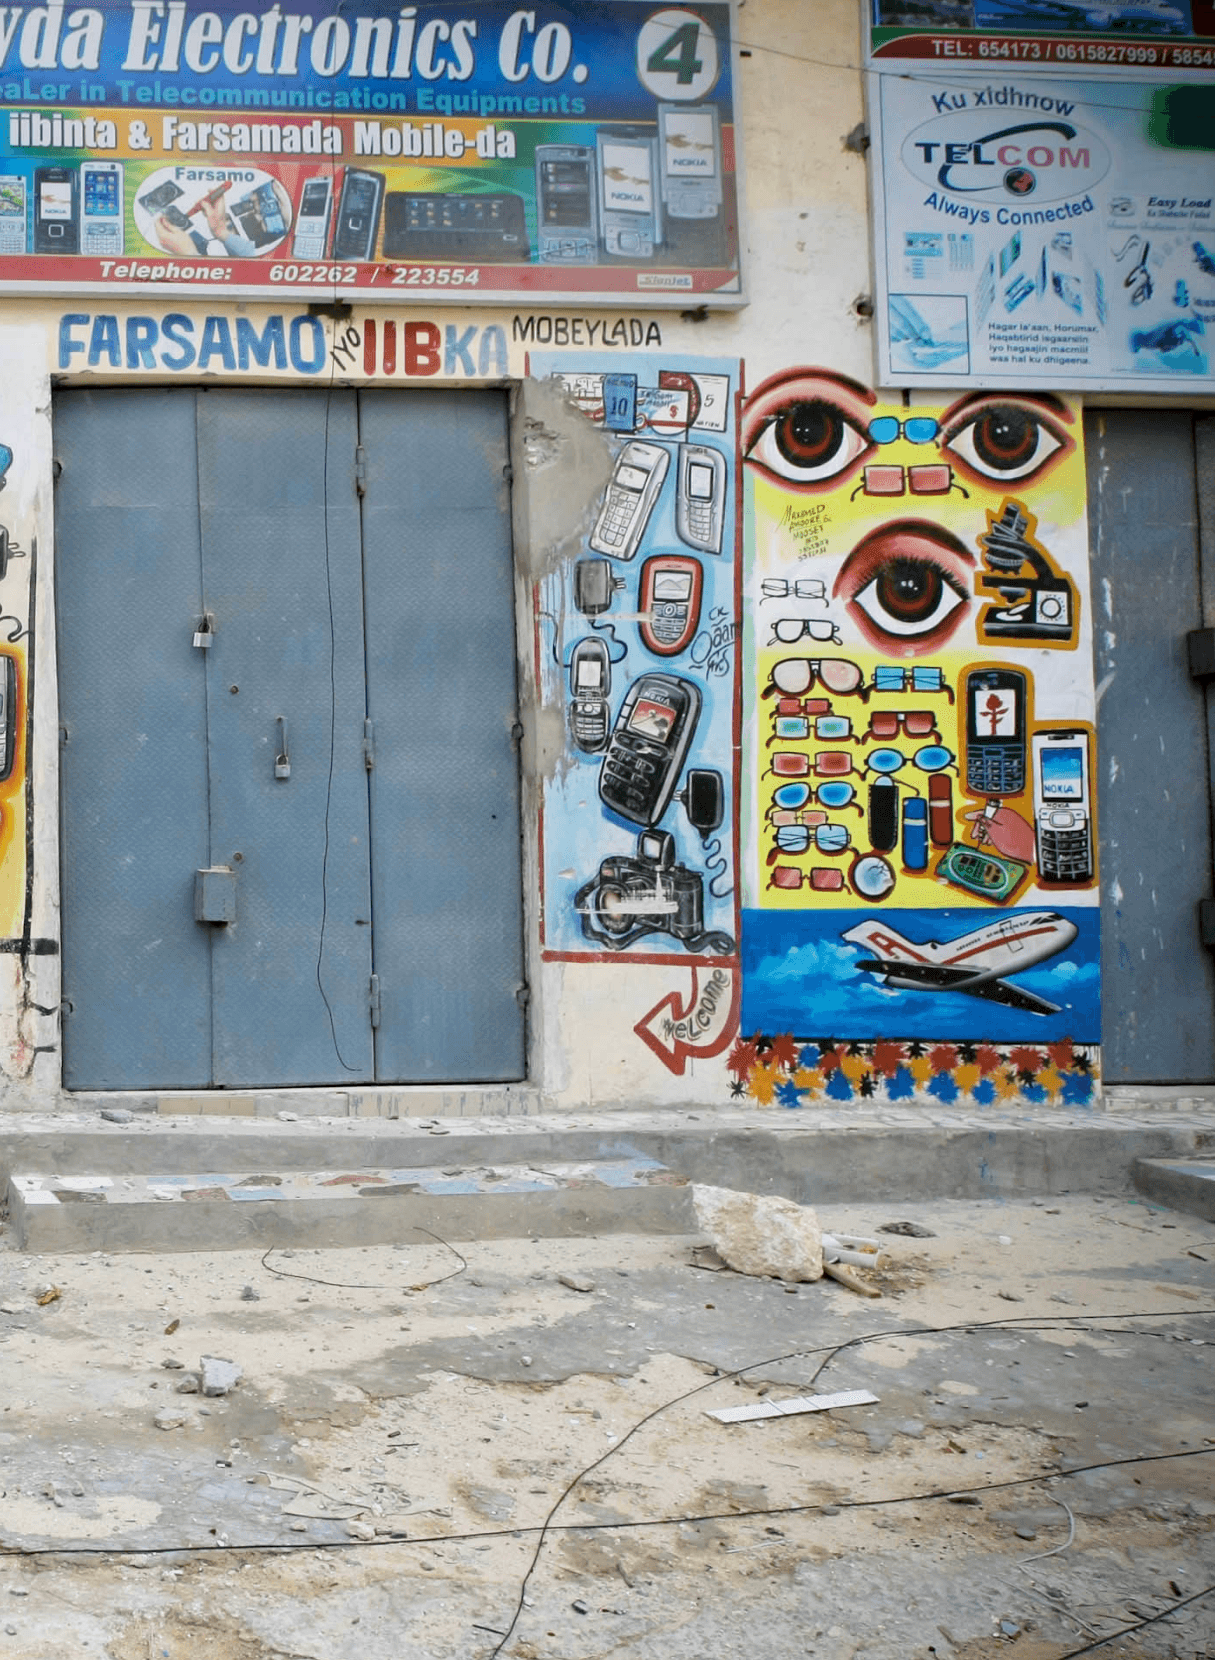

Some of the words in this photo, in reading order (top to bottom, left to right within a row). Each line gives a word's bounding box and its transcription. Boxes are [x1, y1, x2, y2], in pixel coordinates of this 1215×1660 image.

[121, 1, 477, 80] Electronics
[498, 10, 588, 83] Co.
[646, 22, 703, 85] 4
[932, 40, 973, 57] TEL:
[978, 42, 1041, 58] 654173
[1056, 43, 1158, 63] 0615827999
[1172, 48, 1215, 66] 5854
[80, 79, 106, 101] in
[116, 80, 407, 109] Telecommunication
[416, 88, 586, 115] Equipments
[932, 90, 966, 113] Ku
[974, 86, 1075, 117] xidhnow
[128, 120, 151, 150] &
[162, 116, 343, 154] Farsamada
[353, 121, 516, 159] Mobile-da
[672, 158, 708, 167] NOKIA
[914, 142, 1091, 168] TELCOM
[174, 167, 255, 183] Farsamo
[611, 191, 645, 202] NOKIA
[924, 191, 991, 225] Always
[996, 195, 1095, 225] Connected
[1147, 197, 1178, 209] Easy
[1180, 198, 1213, 208] Load
[100, 261, 232, 284] Telephone:
[269, 265, 358, 283] 602262
[391, 267, 481, 286] 223554
[58, 313, 327, 374] FARSAMO
[363, 319, 509, 377] IIBKA
[512, 315, 662, 346] MOBEYLADA
[611, 396, 629, 417] 10
[1045, 784, 1075, 794] NOKIA
